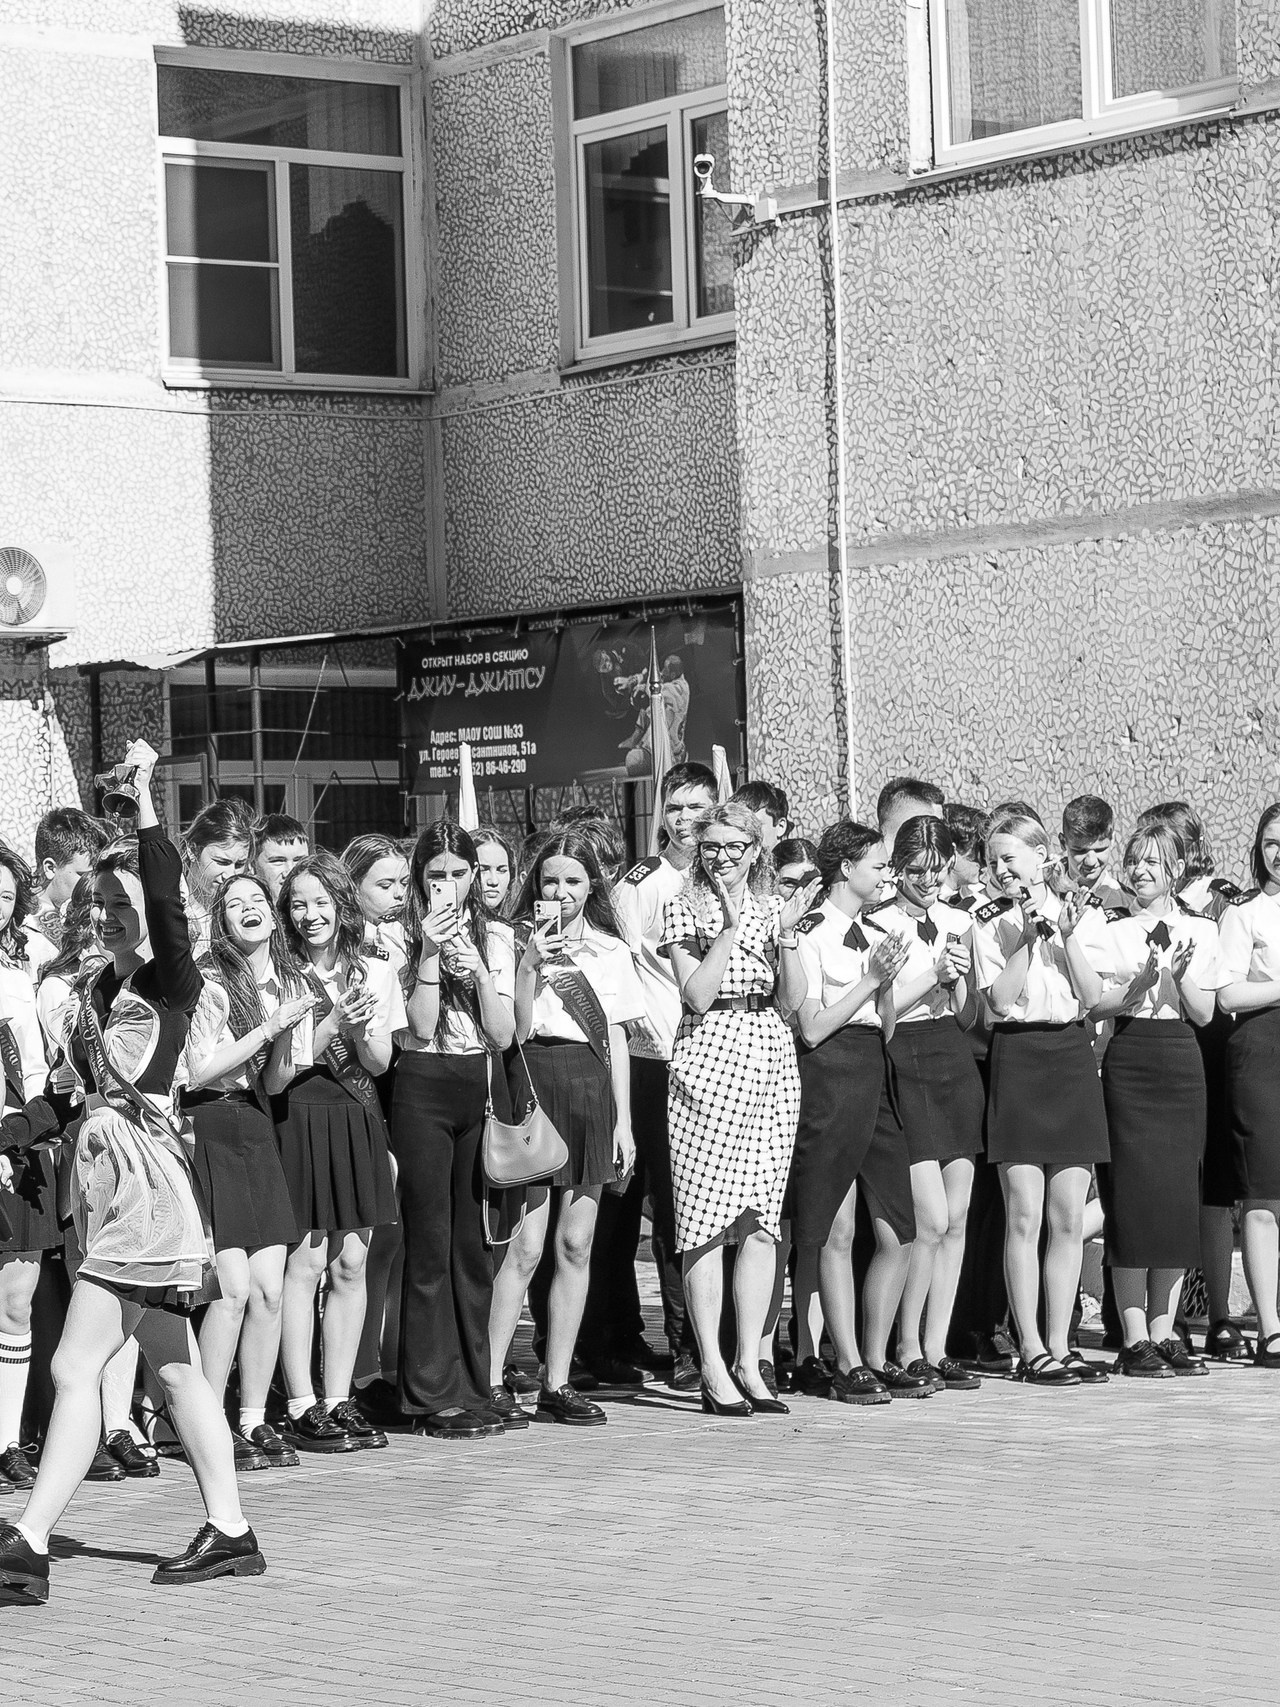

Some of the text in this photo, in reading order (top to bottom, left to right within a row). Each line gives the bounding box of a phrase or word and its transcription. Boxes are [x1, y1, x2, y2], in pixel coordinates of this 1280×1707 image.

[421, 648, 529, 670] ОТКРЫТ НАБОР В СЕКЦИЮ
[407, 665, 546, 702] ДЖИУ-ДЖИТСУ
[430, 723, 524, 747] Адрес: МАОУ СОШ №33
[418, 741, 537, 765] ул. Героев сантников, 51а
[429, 765, 452, 779] тел.:
[485, 758, 526, 776] 86-46-290
